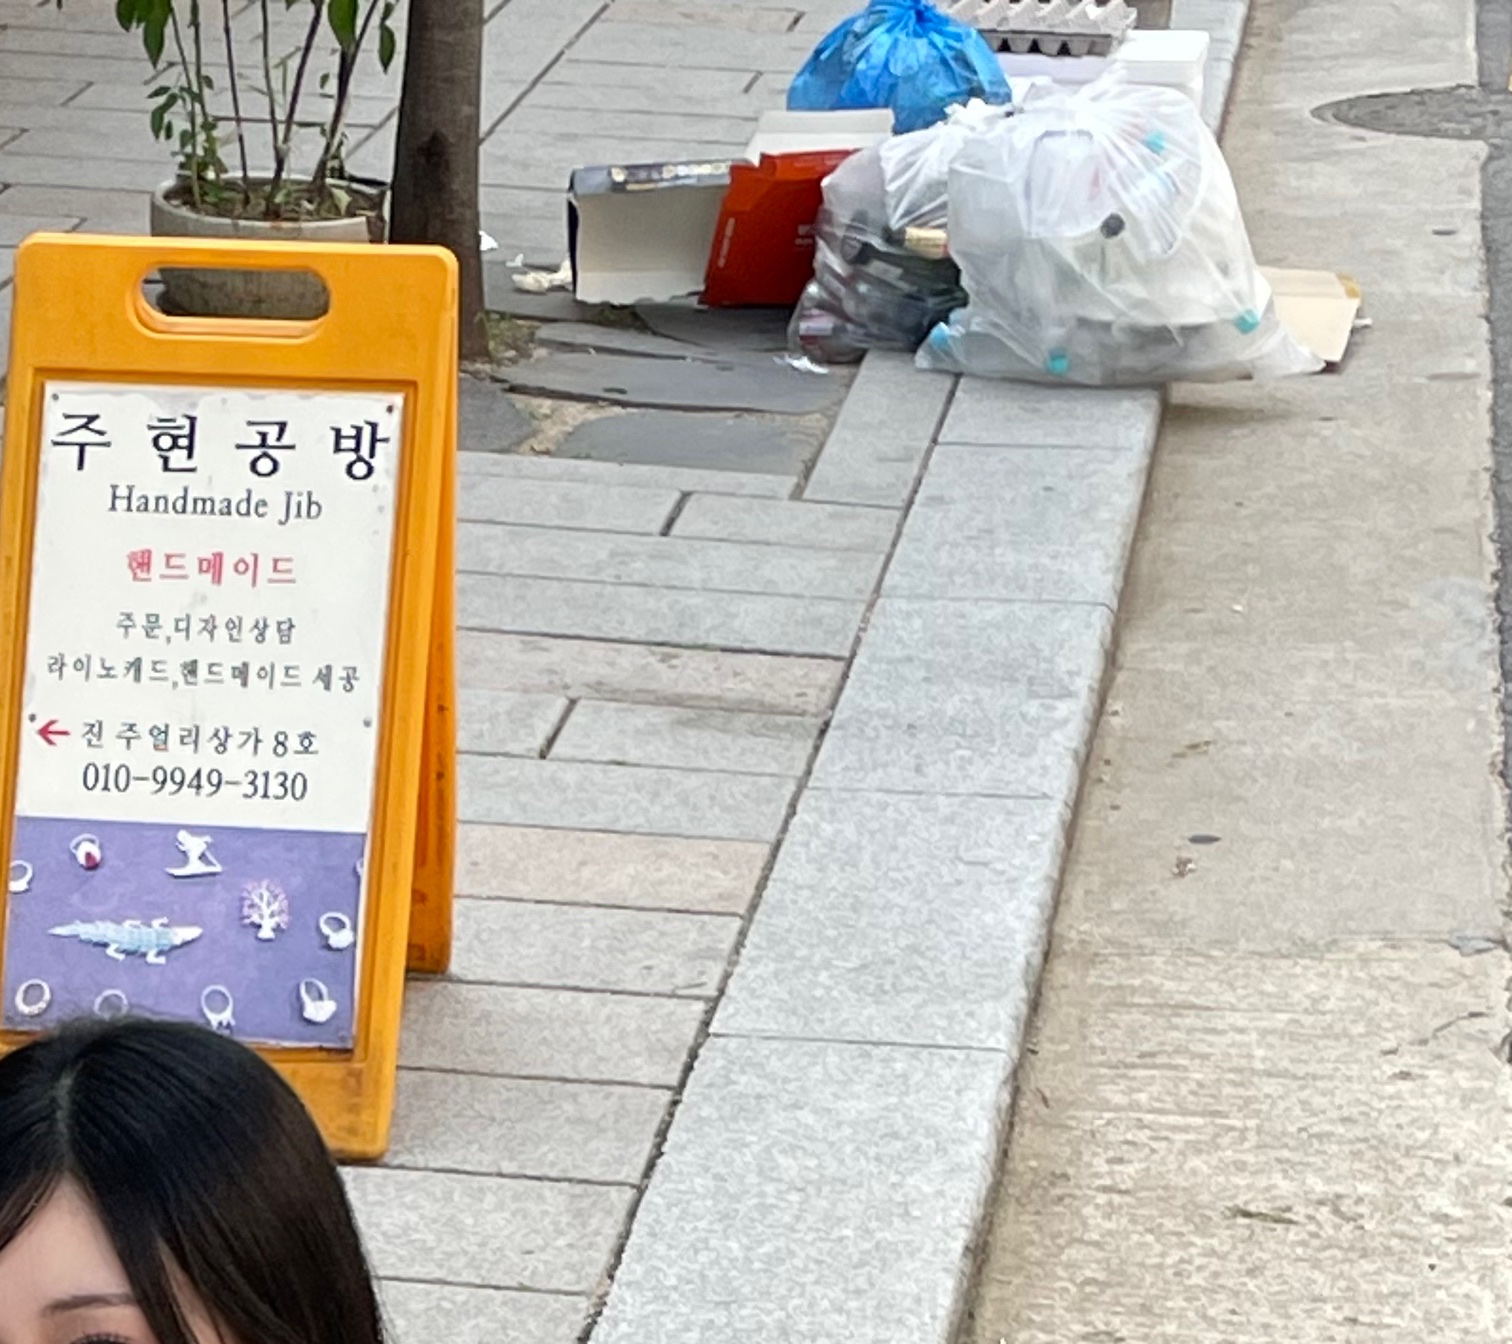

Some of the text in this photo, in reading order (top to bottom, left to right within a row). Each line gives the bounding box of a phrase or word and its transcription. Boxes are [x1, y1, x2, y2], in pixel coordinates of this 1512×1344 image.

[107, 484, 323, 526] Handmade Jib
[126, 548, 297, 588] 핸드메이드
[312, 664, 361, 693] 세공
[82, 761, 309, 802] 010-9949-3130
